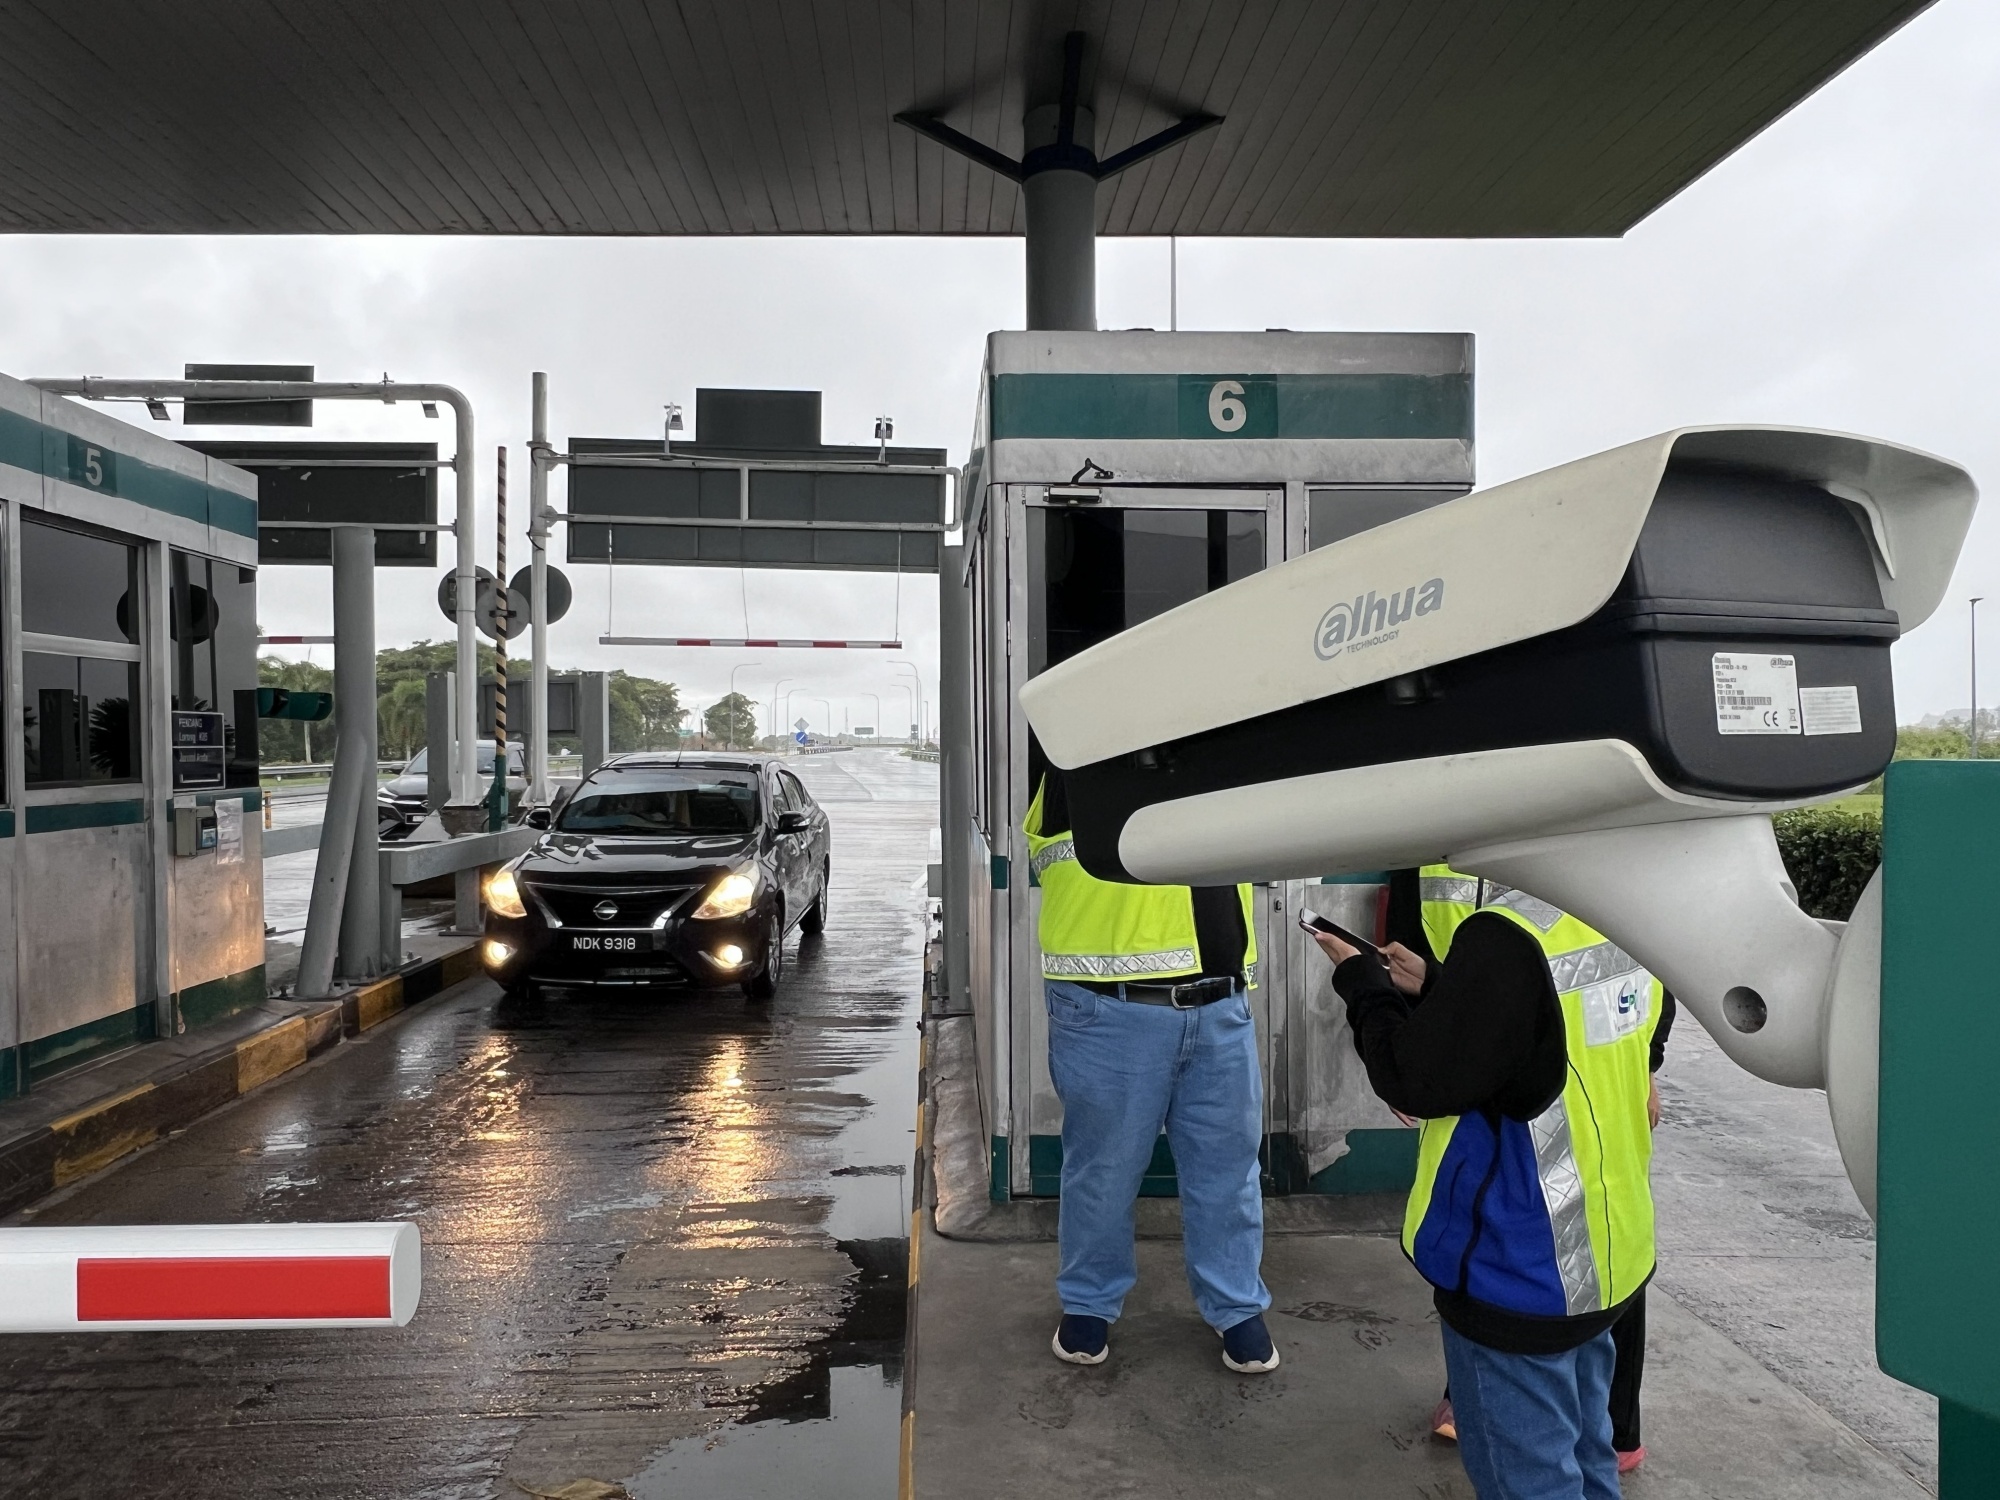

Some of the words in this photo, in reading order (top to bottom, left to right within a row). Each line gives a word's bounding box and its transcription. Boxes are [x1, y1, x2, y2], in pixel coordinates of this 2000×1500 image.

[1208, 380, 1247, 432] 6
[85, 447, 103, 486] 5
[1346, 629, 1400, 653] TECHNOLOGY
[573, 937, 601, 950] NDK
[604, 937, 636, 950] 9318
